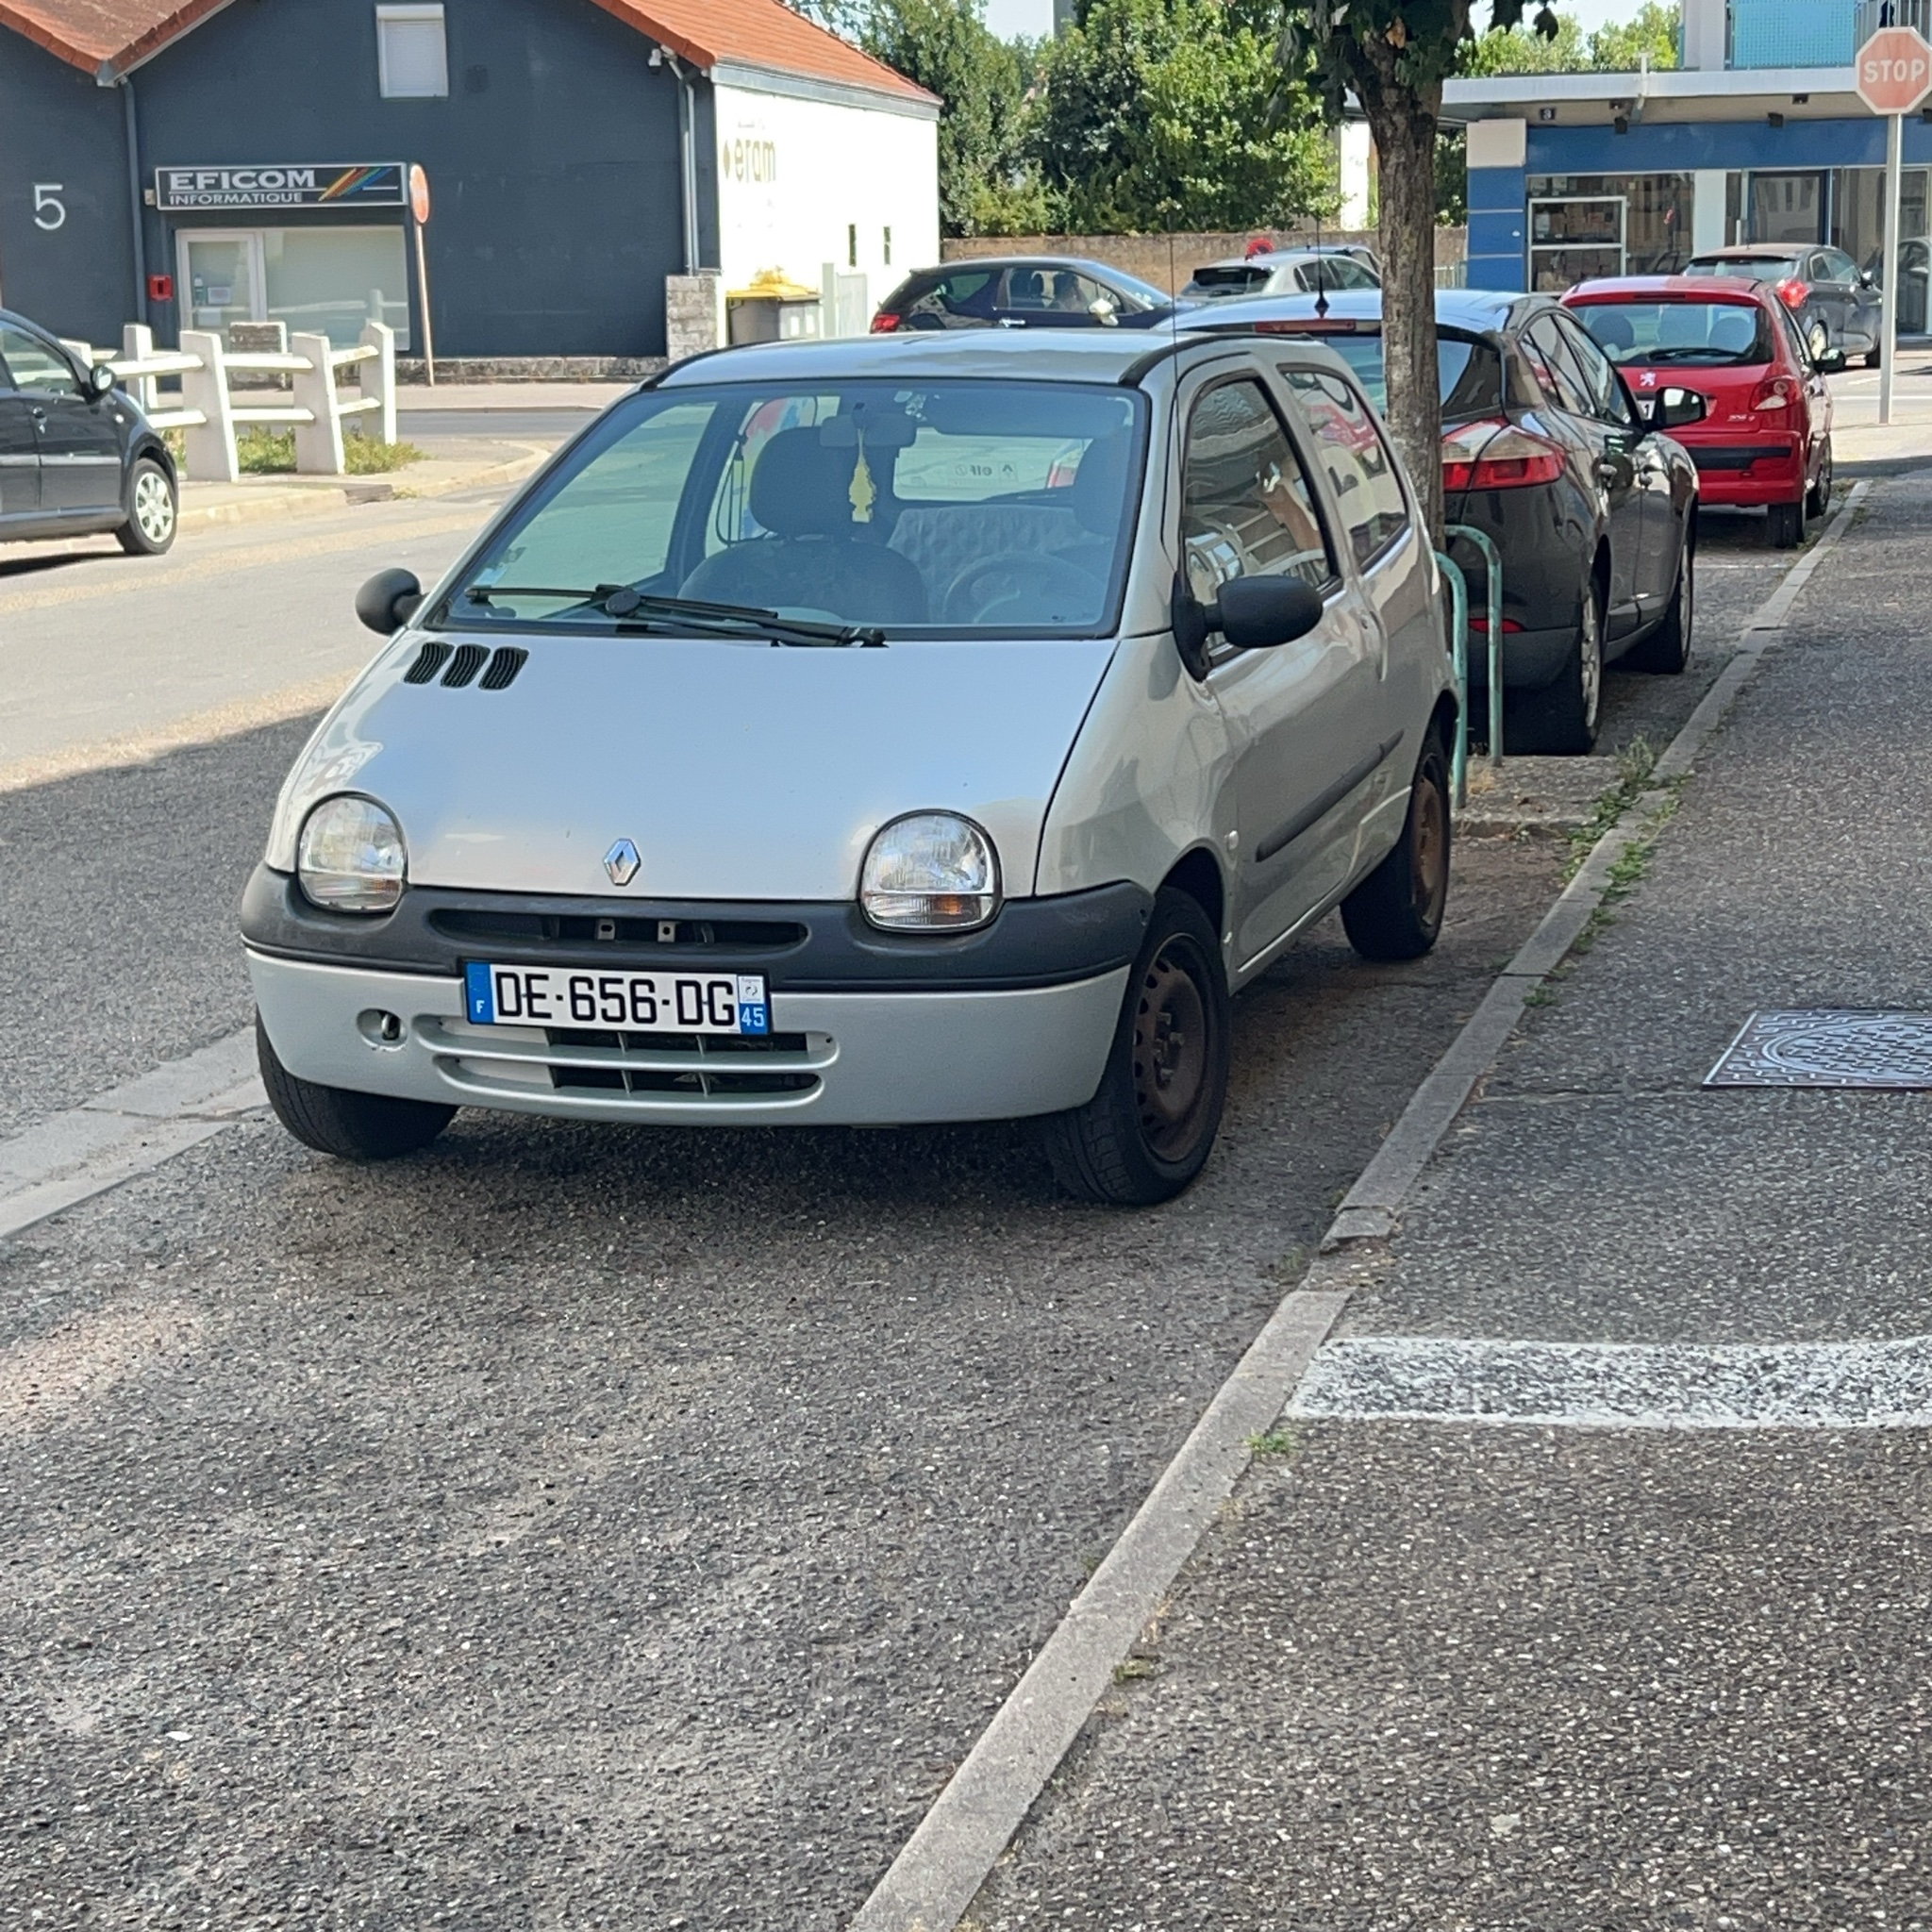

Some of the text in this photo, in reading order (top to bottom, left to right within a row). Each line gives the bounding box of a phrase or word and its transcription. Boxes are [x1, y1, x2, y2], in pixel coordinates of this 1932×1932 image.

[1864, 58, 1925, 83] STOP
[735, 139, 775, 183] eram
[169, 170, 315, 190] EFICOM
[35, 185, 65, 229] 5
[170, 192, 303, 206] INFORMATIQUE
[476, 1000, 485, 1014] F
[495, 972, 736, 1026] DE-656-DG
[741, 1007, 765, 1026] 45
